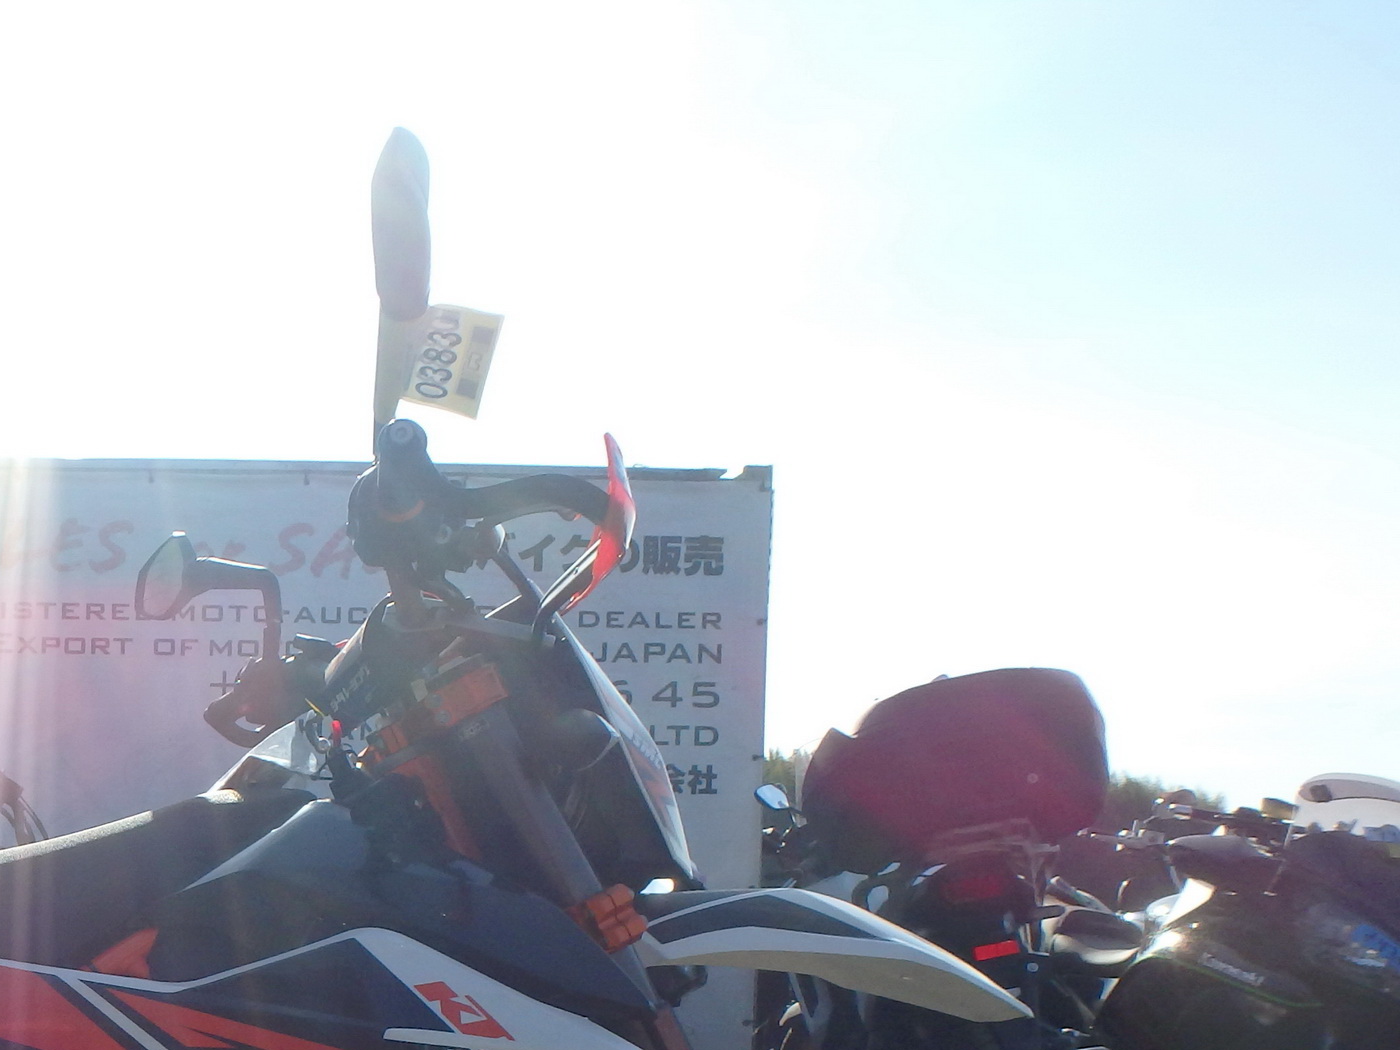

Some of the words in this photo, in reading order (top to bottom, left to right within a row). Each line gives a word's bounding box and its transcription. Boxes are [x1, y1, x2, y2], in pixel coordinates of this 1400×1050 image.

[578, 611, 723, 630] DEALER
[153, 637, 199, 657] OF
[596, 642, 723, 665] JAPAN
[651, 680, 721, 709] 45
[649, 724, 719, 746] LTD
